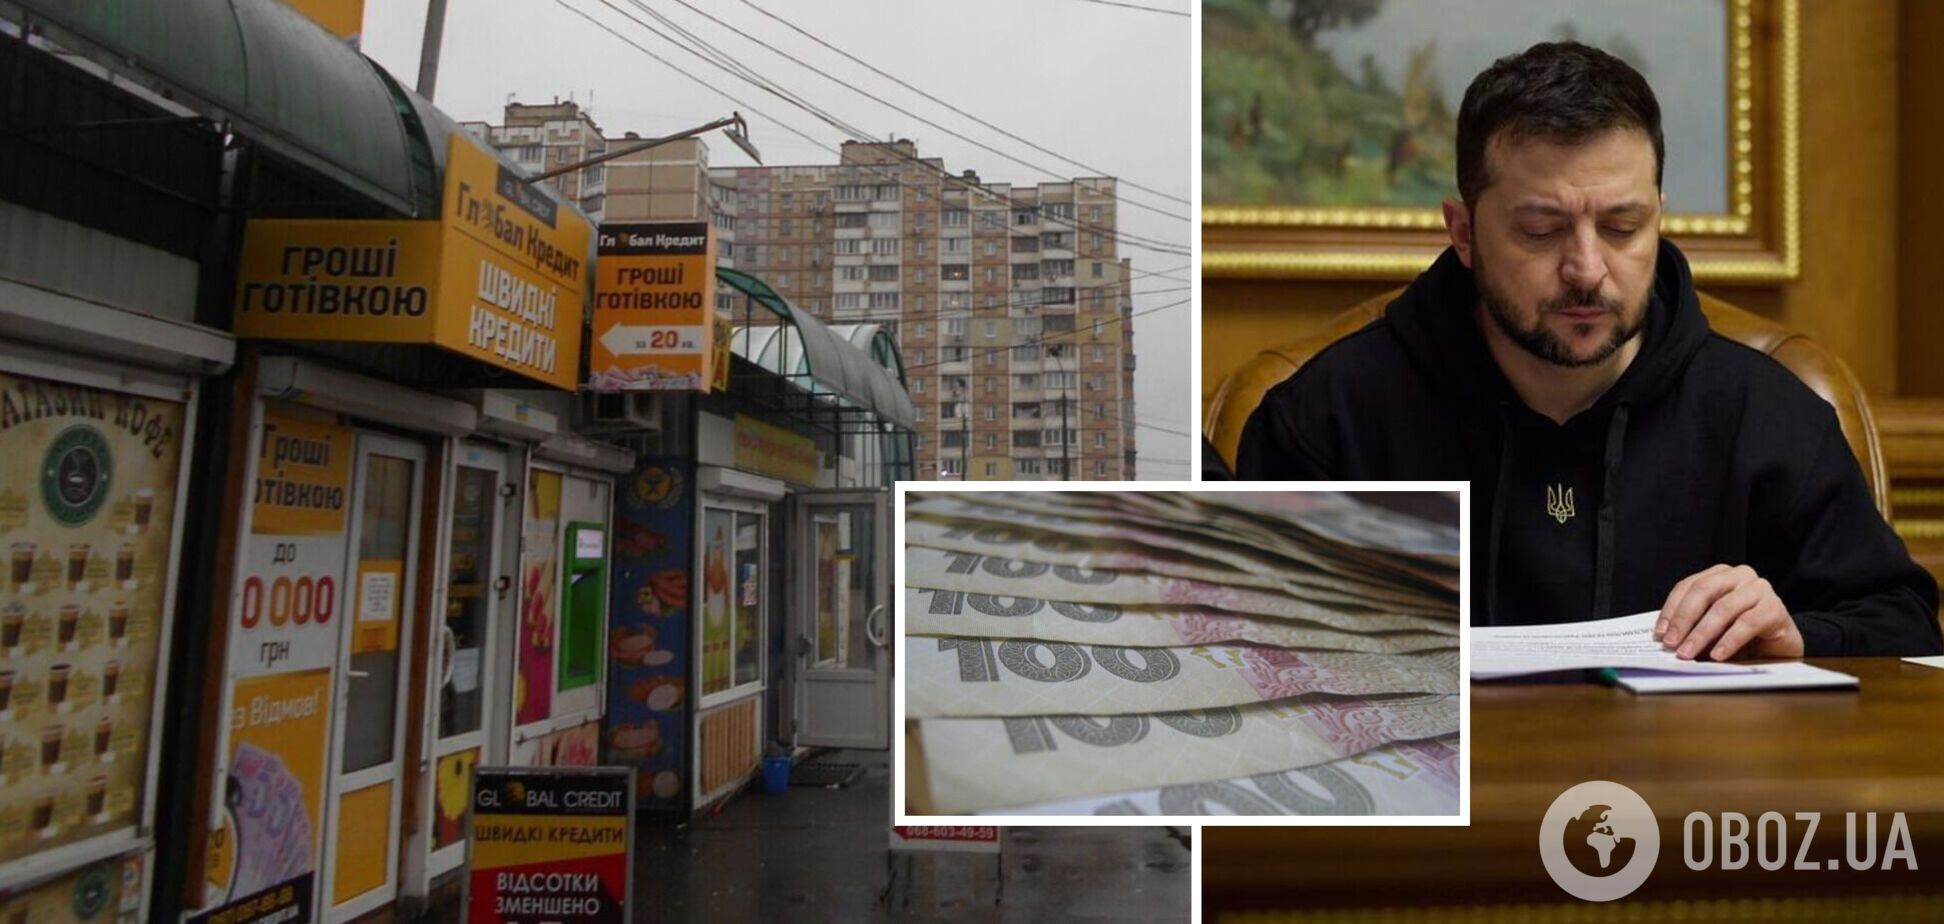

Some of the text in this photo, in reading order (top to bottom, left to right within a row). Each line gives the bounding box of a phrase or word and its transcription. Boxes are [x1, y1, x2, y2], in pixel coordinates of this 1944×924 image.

[655, 233, 705, 249] Кредит
[243, 276, 428, 316] ГОТІВКОЮ
[469, 305, 556, 374] КРЕДИТИ
[651, 330, 679, 349] 20
[273, 543, 297, 566] до
[260, 641, 290, 668] грн
[938, 638, 1181, 683] 100
[563, 790, 622, 808] CREDIT
[475, 825, 623, 844] ШВИДКІ КРЕДИТИ
[496, 872, 600, 893] ВІДСОТКИ
[494, 897, 600, 916] ЗМЕНШЕНО
